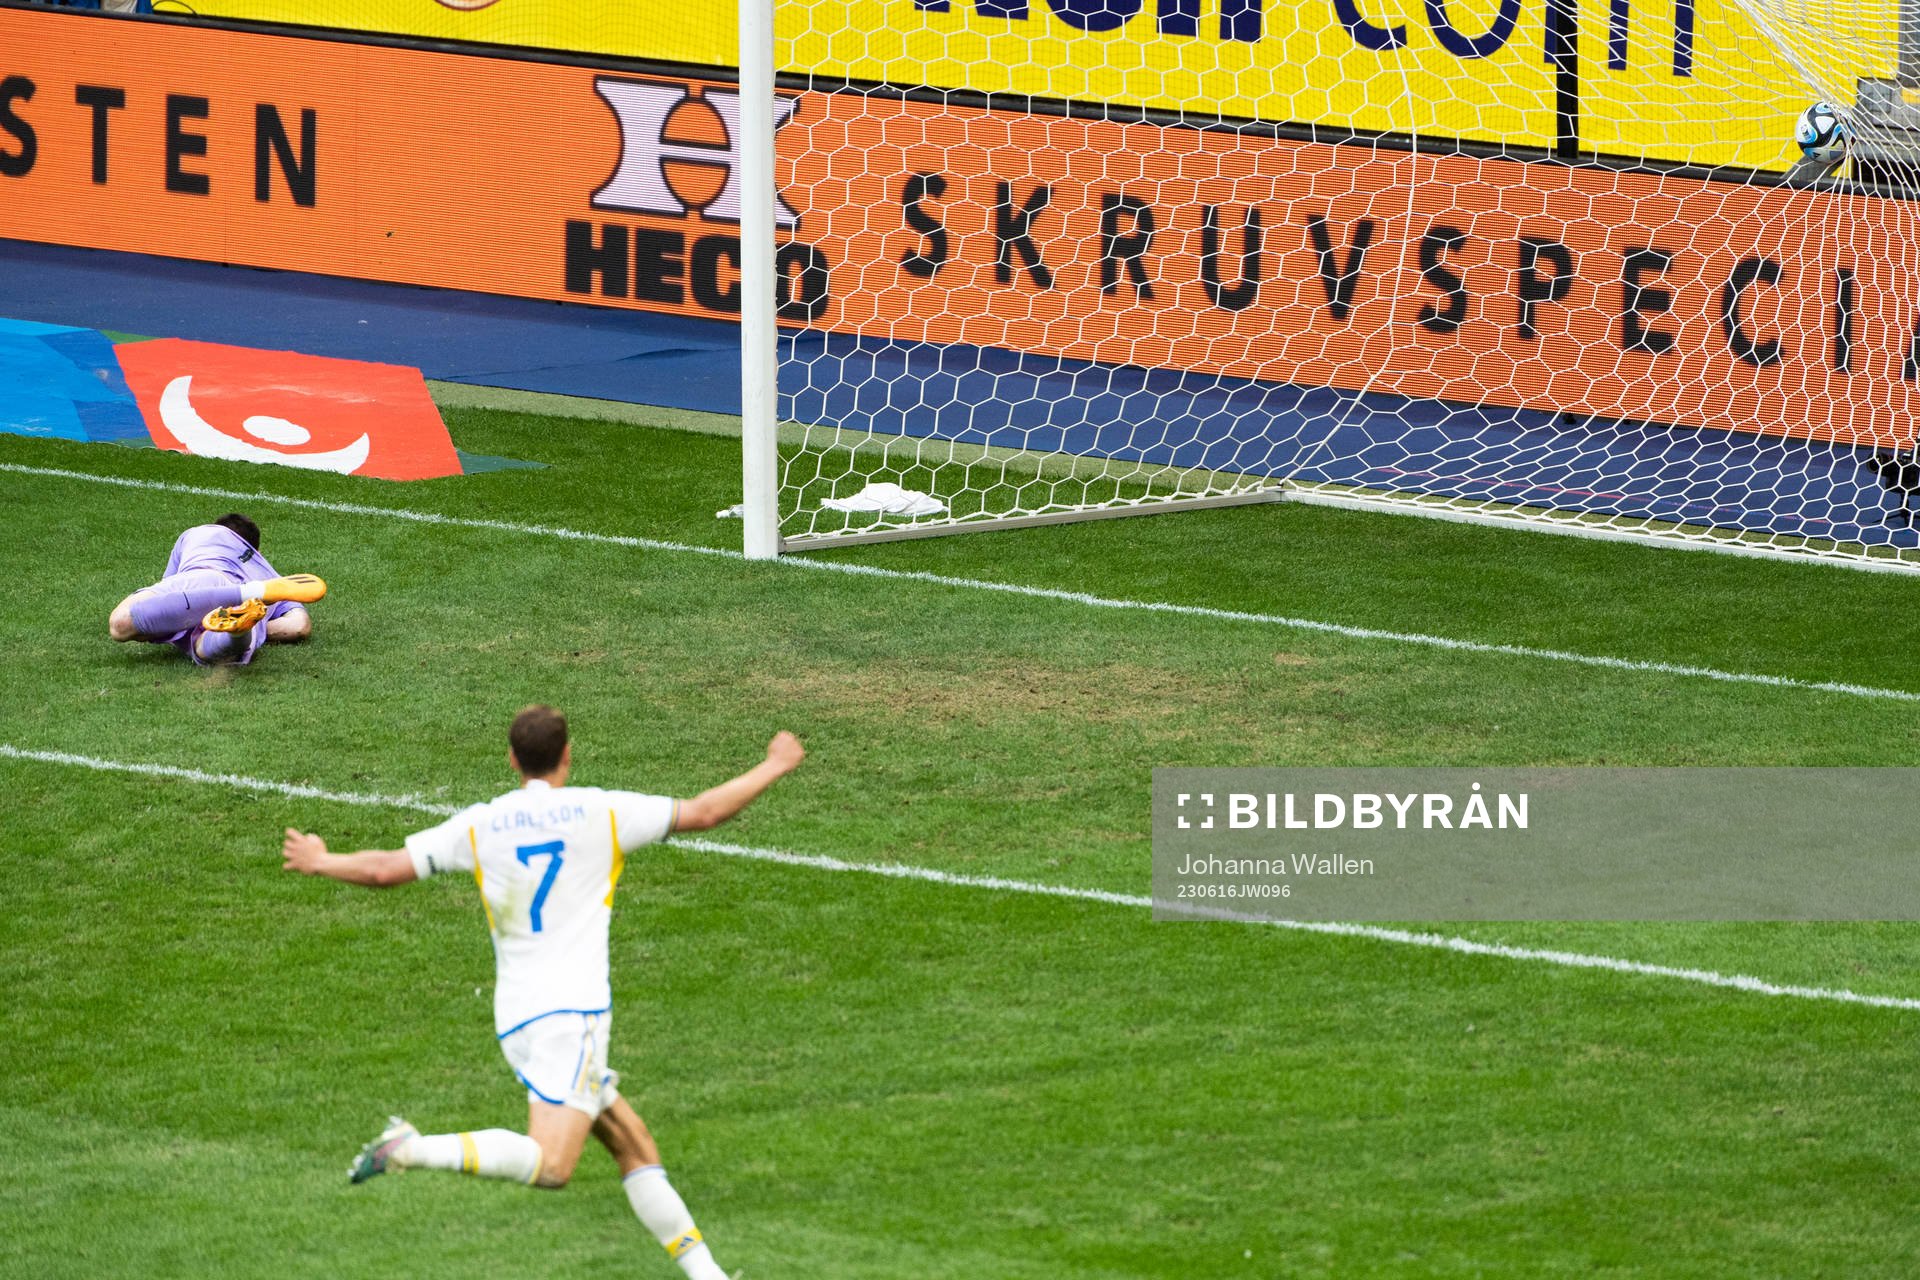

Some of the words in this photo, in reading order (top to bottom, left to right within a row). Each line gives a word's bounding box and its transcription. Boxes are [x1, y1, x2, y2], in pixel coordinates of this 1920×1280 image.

[565, 219, 829, 321] HECO
[902, 170, 1920, 381] SKRUVSPECI
[516, 840, 564, 932] 7
